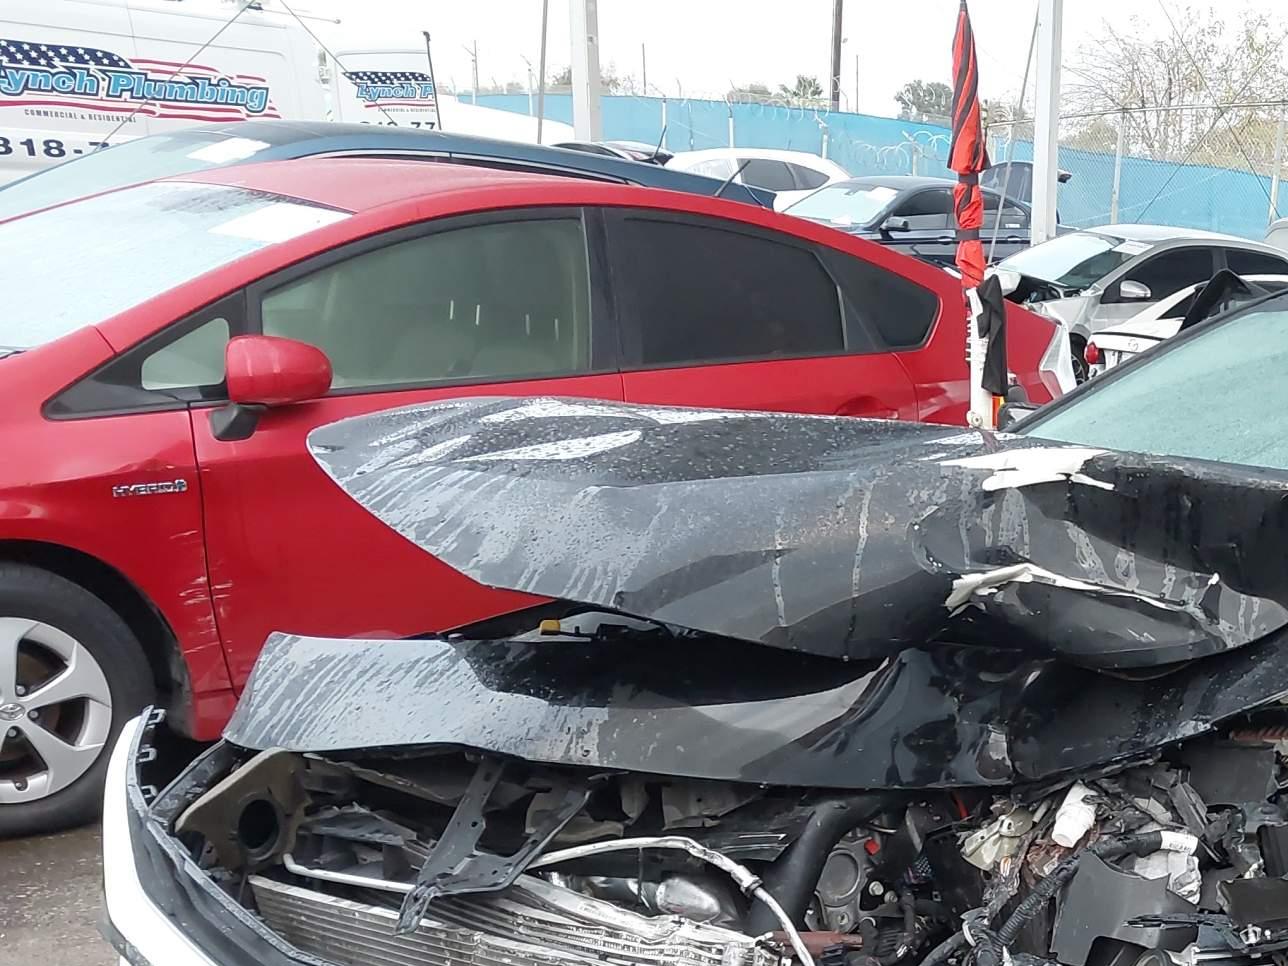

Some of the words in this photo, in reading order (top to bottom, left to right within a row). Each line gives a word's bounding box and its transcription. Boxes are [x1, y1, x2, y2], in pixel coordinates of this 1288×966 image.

[108, 72, 267, 111] Plumbing
[358, 84, 416, 101] Lynch
[24, 108, 78, 120] COMMERCIAL
